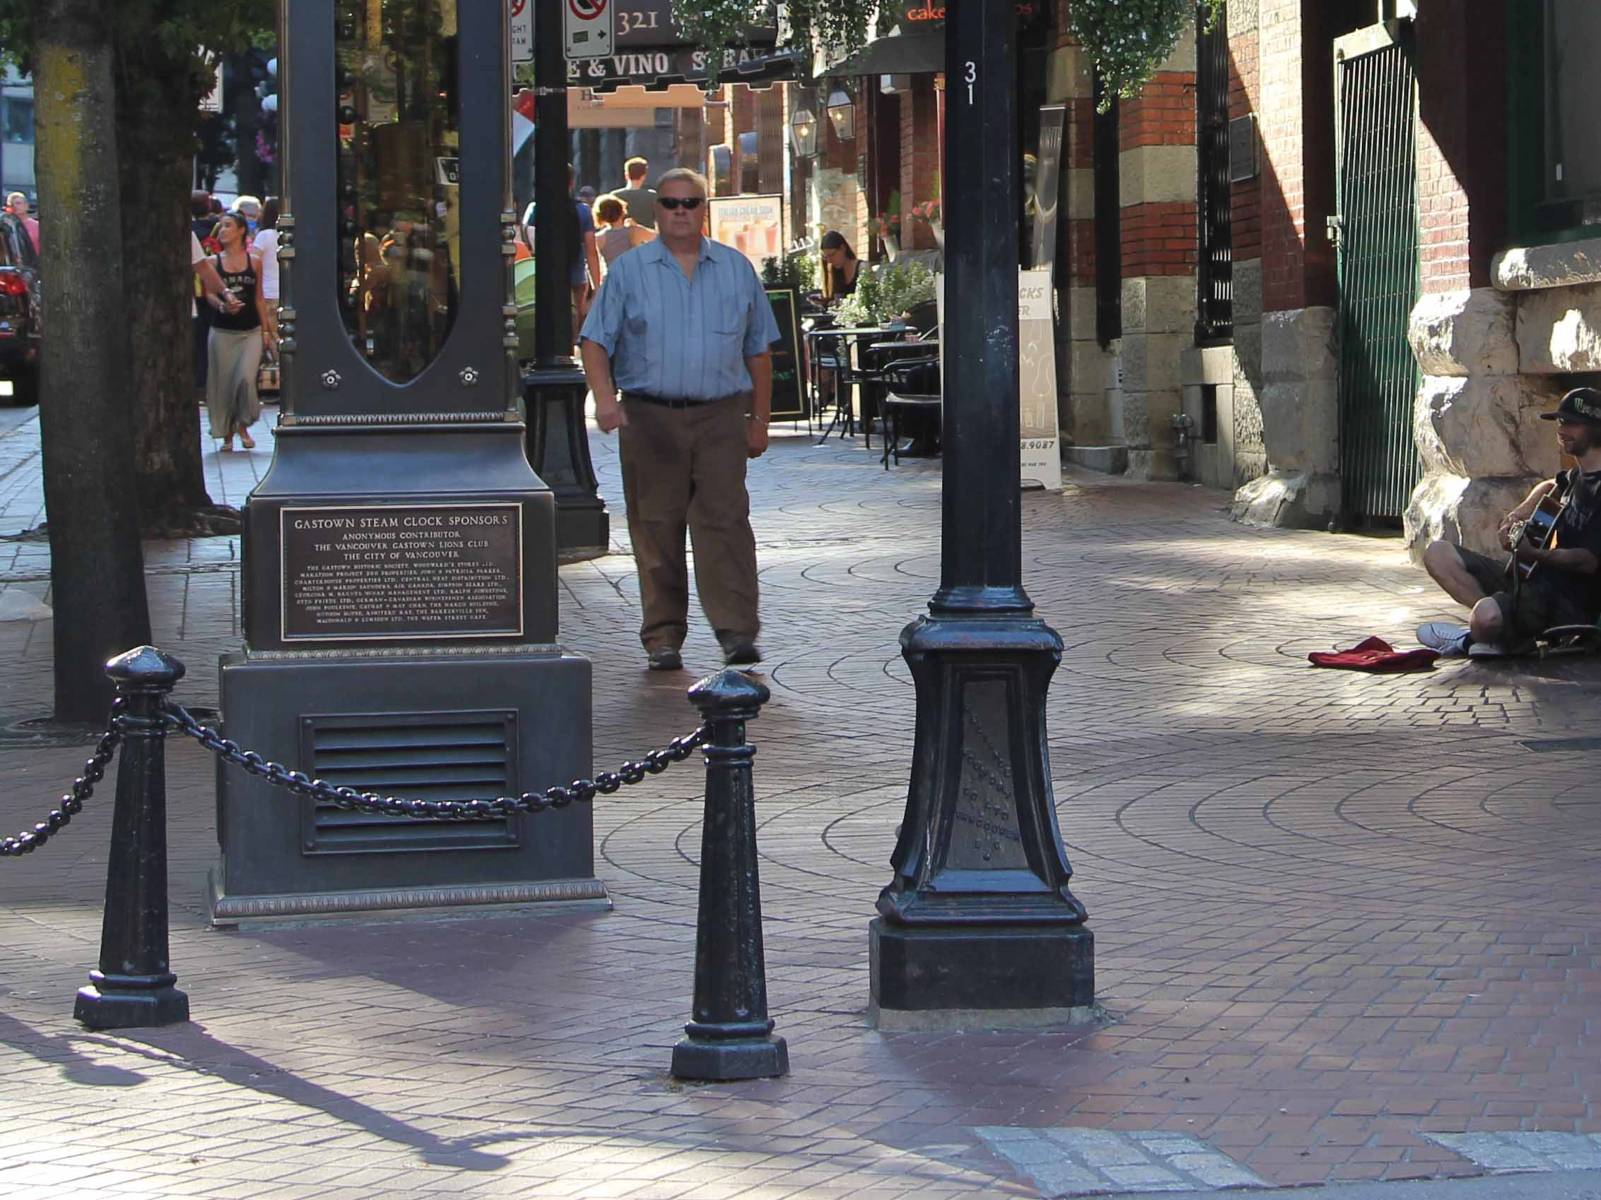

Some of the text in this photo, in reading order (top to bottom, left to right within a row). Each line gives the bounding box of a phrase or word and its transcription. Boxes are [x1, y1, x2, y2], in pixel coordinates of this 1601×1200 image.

[618, 11, 659, 36] 321
[613, 52, 669, 76] VINO
[294, 515, 508, 529] GASTOWN STEAM CLOCK SPONSORS
[400, 531, 461, 539] CONTRIBUTOR
[392, 541, 435, 549] GASTOWN
[440, 540, 463, 548] LIONS
[390, 552, 400, 560] OF
[405, 551, 460, 559] VANCOUVER
